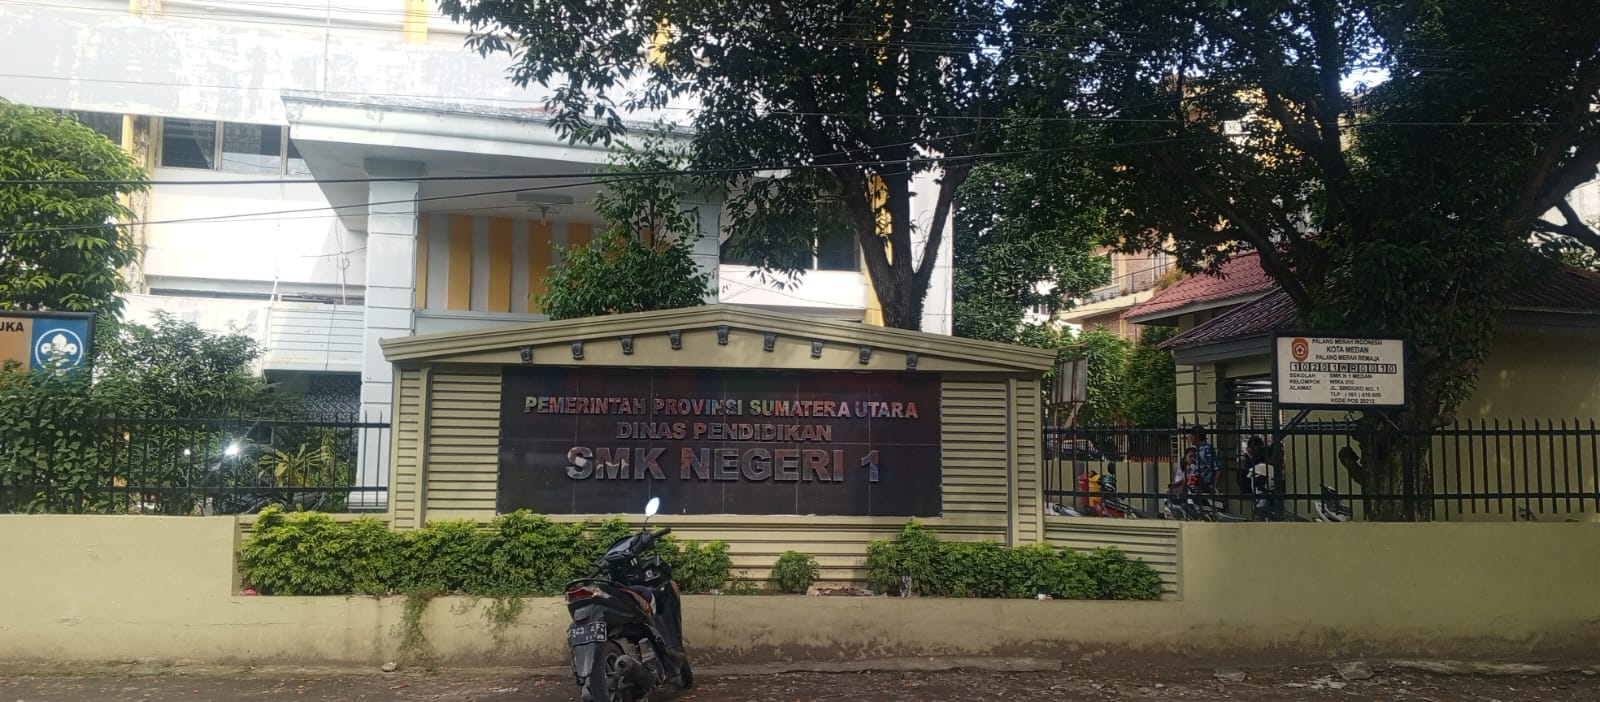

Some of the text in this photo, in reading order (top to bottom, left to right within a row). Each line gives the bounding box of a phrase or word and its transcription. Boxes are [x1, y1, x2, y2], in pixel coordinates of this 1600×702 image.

[1346, 346, 1369, 354] MEDAN
[524, 396, 919, 420] PEMERINTAH PROVINSI SUMATERA UTARA
[616, 421, 834, 443] DINAS PENDIDIKAN
[564, 446, 881, 484] SMK NEGERI 1
